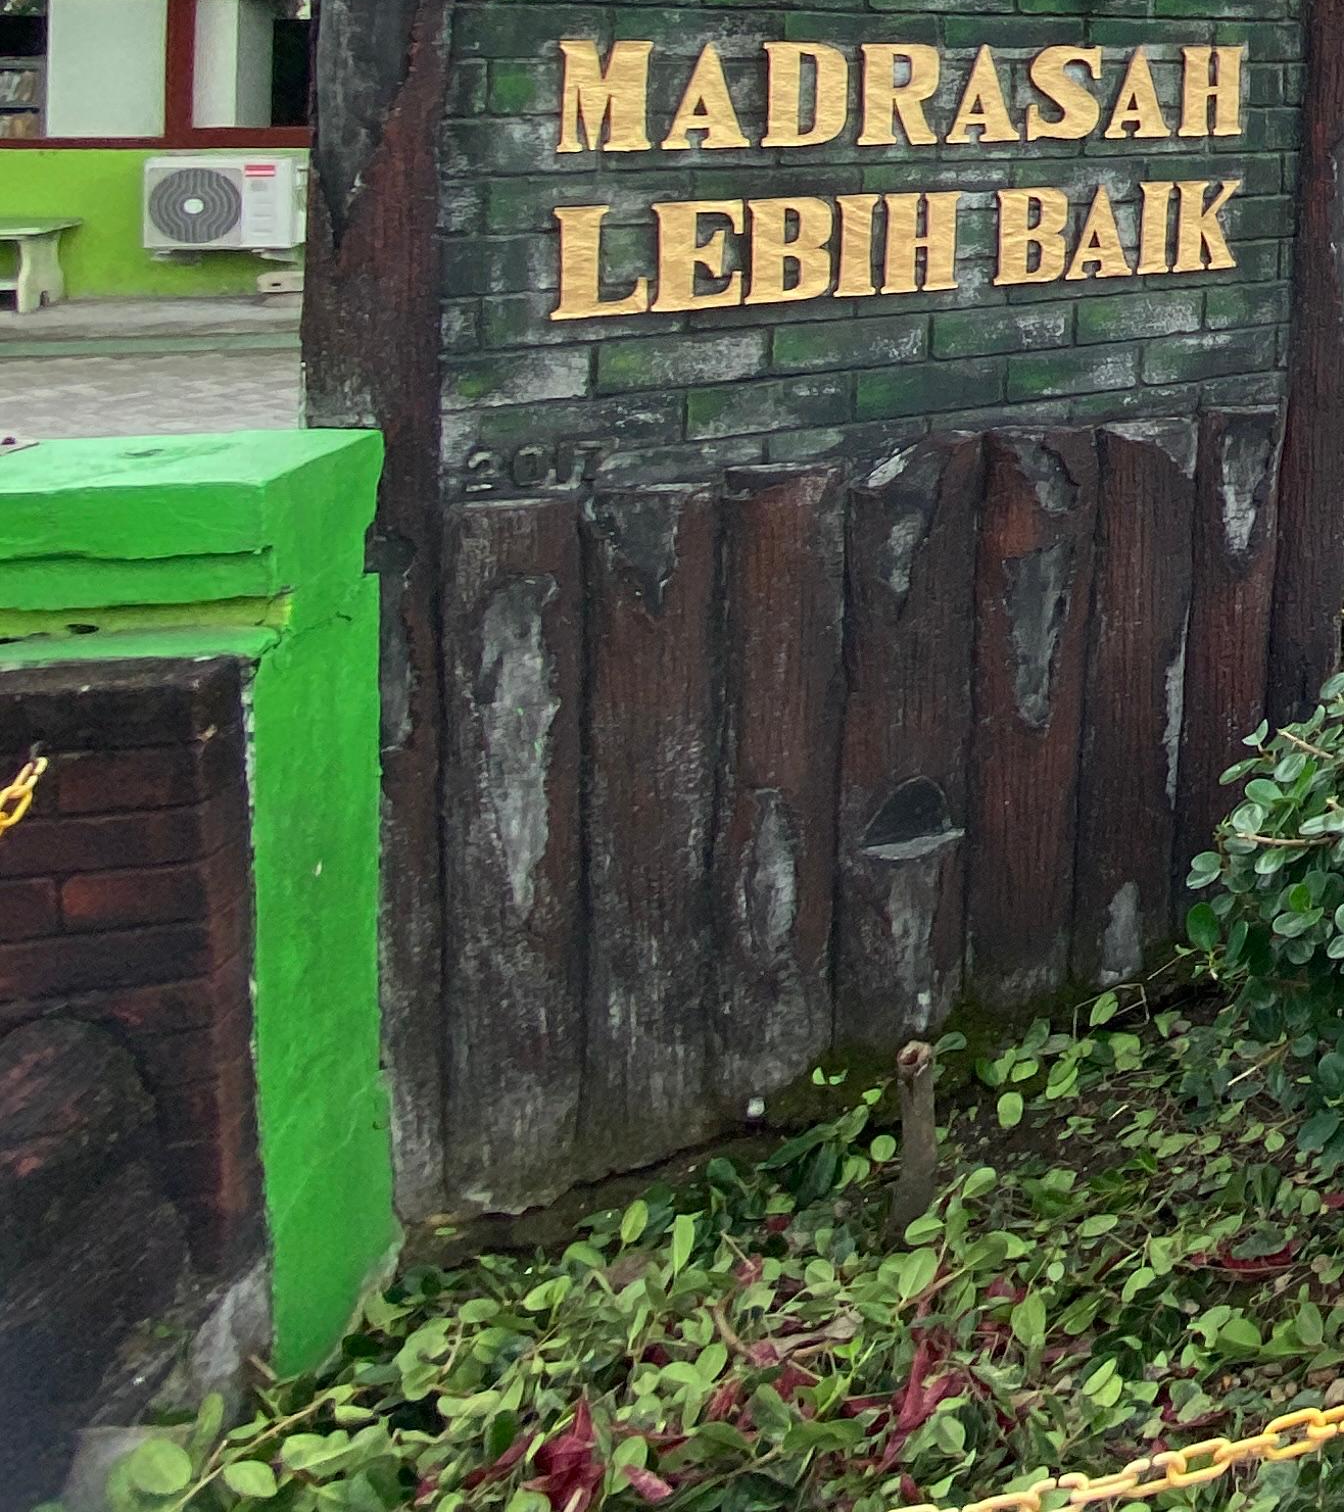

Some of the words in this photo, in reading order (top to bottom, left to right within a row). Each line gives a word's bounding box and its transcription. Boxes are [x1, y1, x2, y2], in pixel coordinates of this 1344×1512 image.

[555, 39, 1245, 154] MADRASAH
[549, 190, 963, 321] LEBIH
[992, 178, 1243, 287] BAIK
